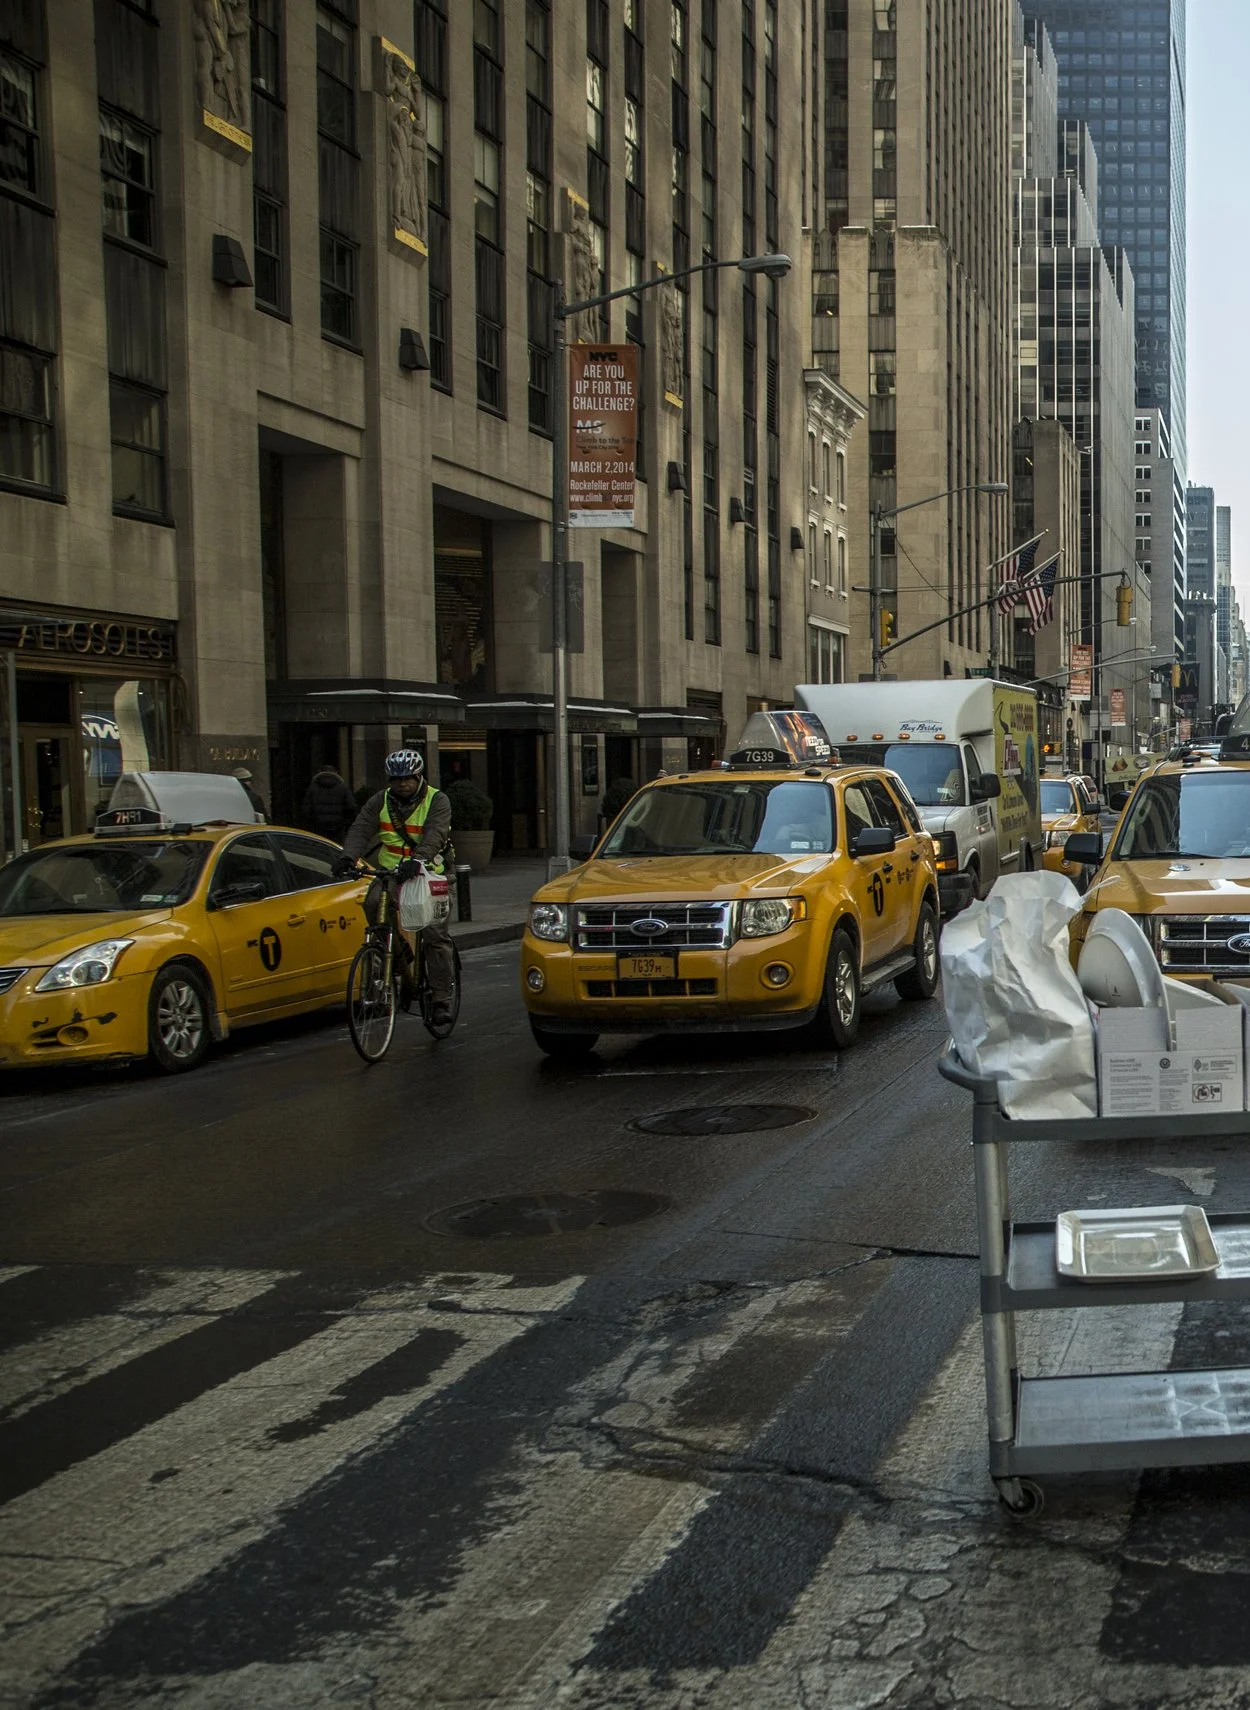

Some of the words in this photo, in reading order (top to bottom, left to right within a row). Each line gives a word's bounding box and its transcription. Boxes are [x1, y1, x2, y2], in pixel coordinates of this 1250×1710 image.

[589, 352, 617, 361] NYC
[584, 365, 602, 378] ARE
[604, 365, 624, 378] YOU
[576, 381, 589, 394] UP
[592, 381, 611, 394] FOR
[614, 382, 632, 394] THE
[573, 396, 635, 411] CHALLENGE?
[576, 420, 602, 434] MS
[571, 462, 602, 473] MARCH
[605, 462, 634, 473] 2,2014
[570, 480, 609, 490] Rockefeller
[612, 480, 633, 490] Center
[18, 622, 163, 659] AEROSOLES
[900, 724, 915, 732] Bay
[916, 724, 942, 732] Bridge
[745, 752, 774, 762] 7G39
[632, 959, 655, 973] 7G39
